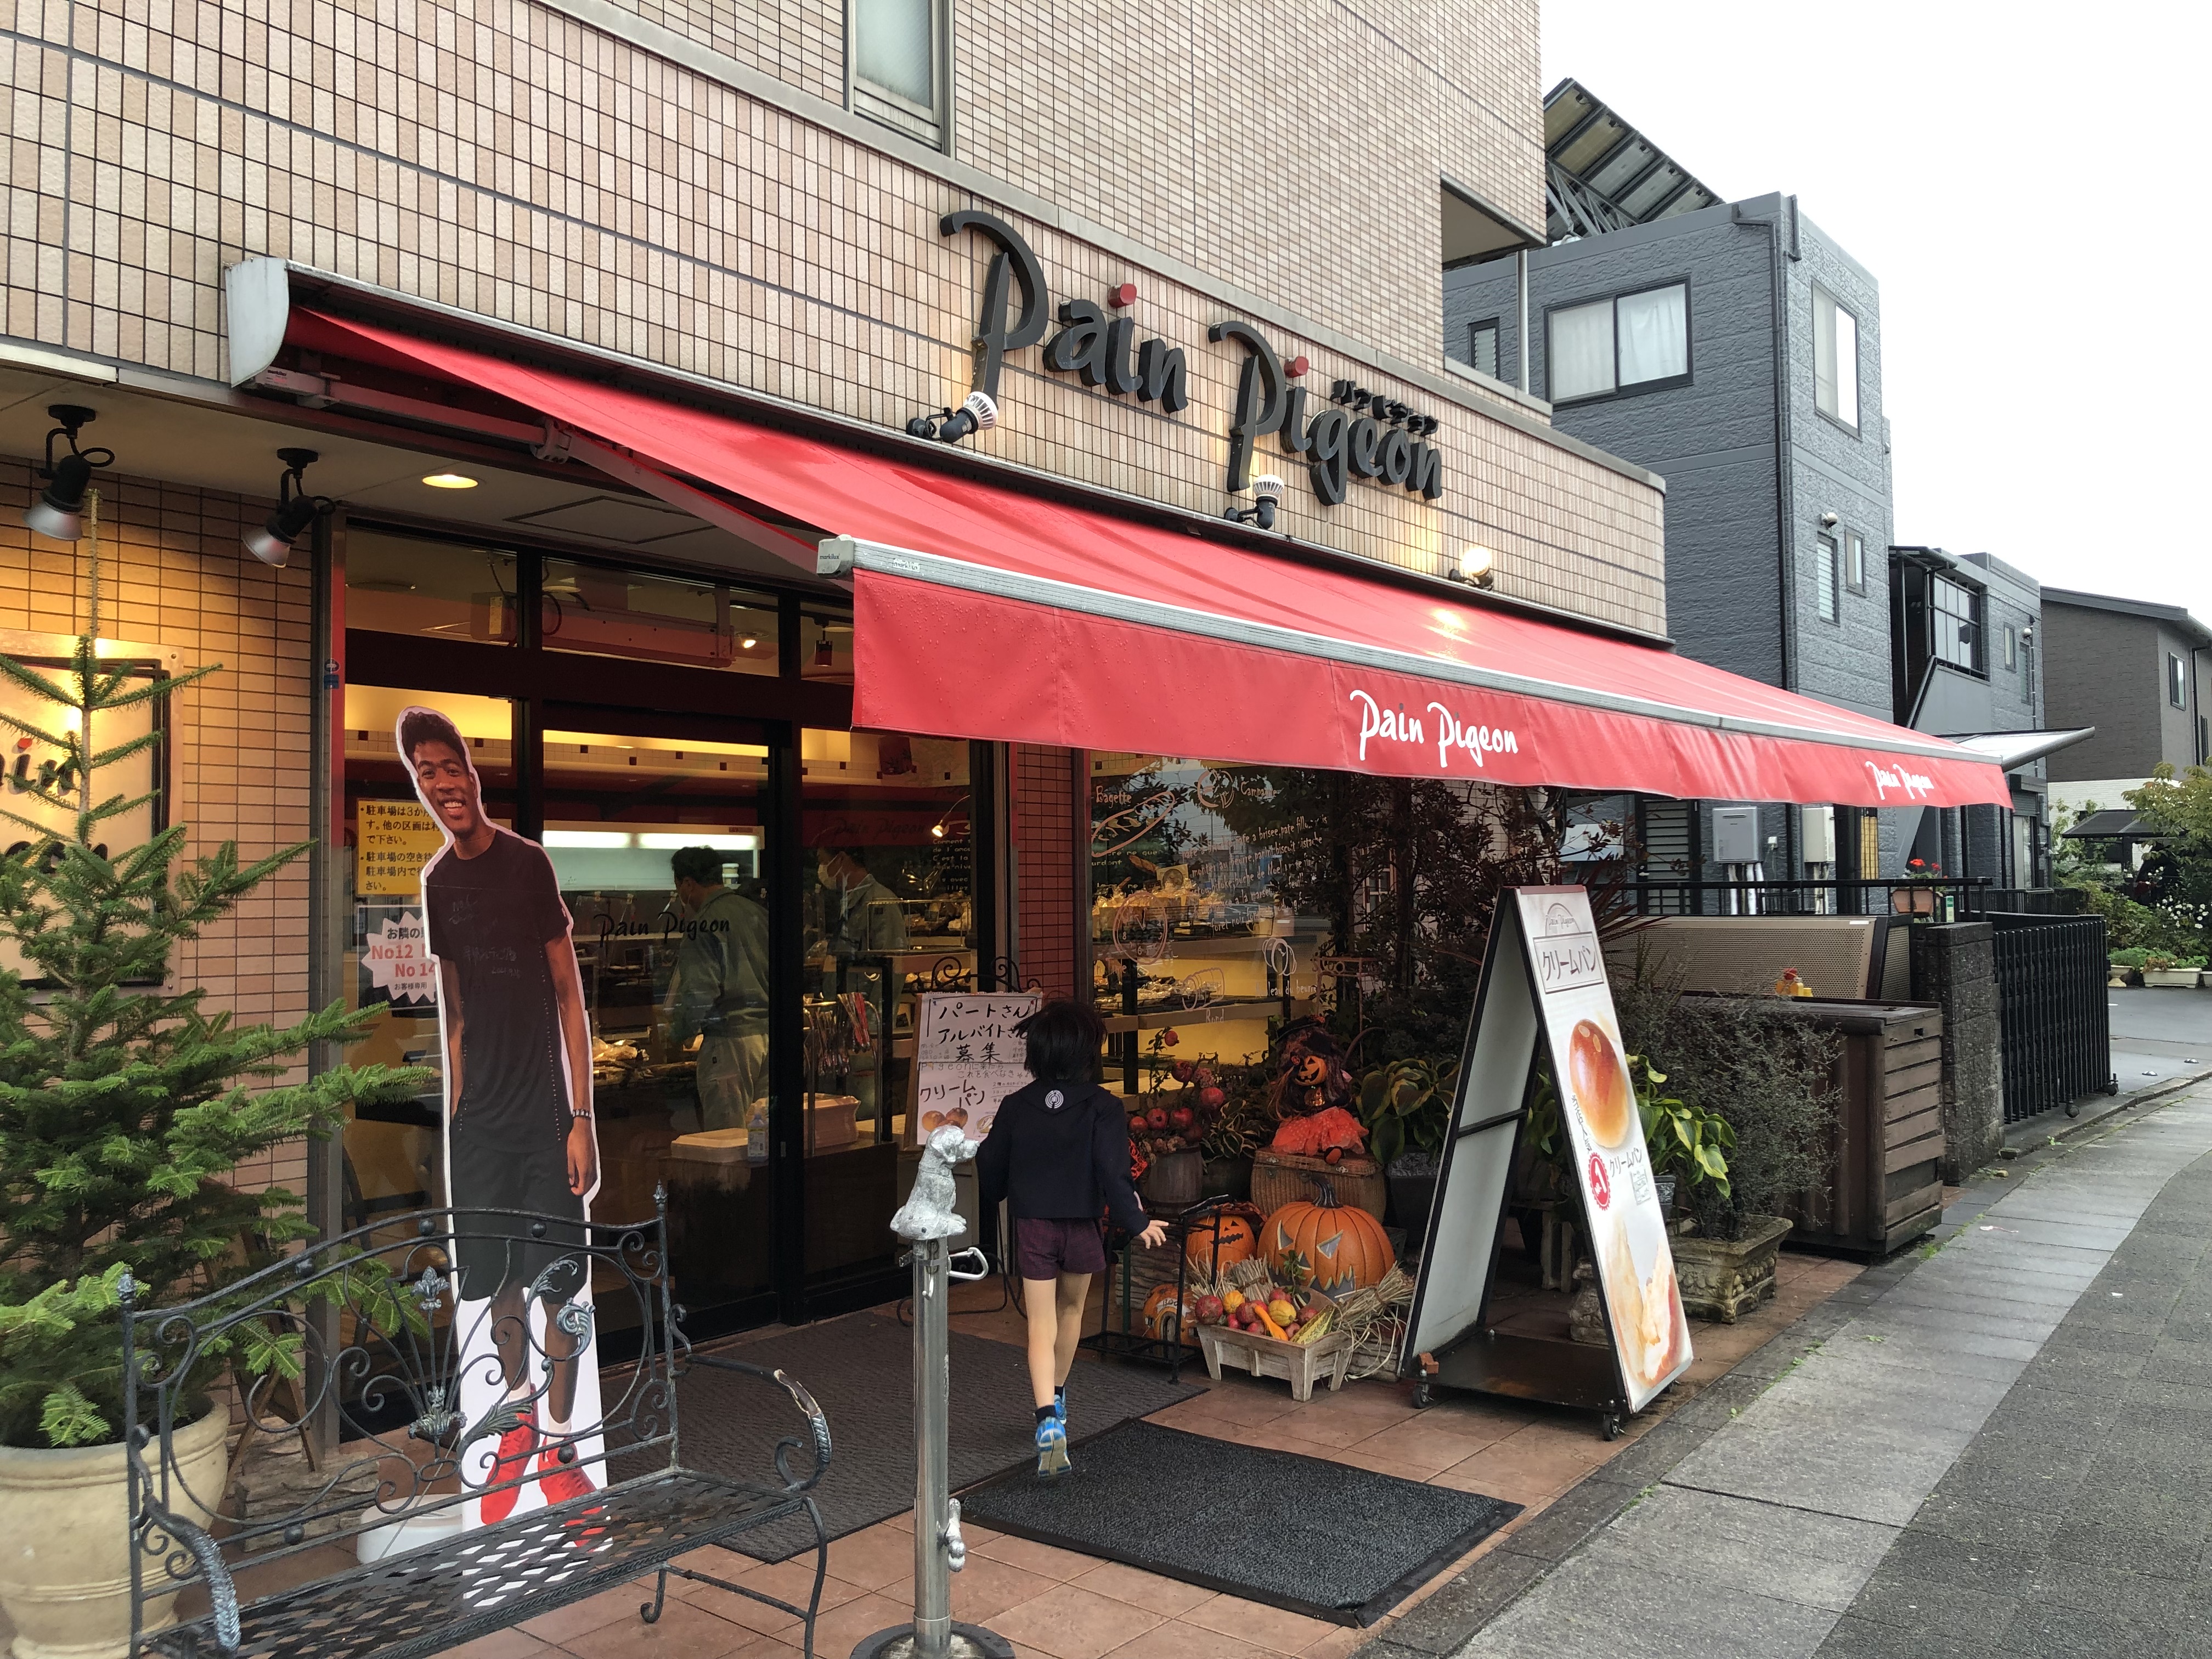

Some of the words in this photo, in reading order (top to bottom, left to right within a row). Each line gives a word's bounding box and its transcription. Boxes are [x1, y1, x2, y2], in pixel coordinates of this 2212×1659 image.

[940, 210, 1188, 413] Pain
[1208, 320, 1442, 506] Pigeon
[1349, 689, 1425, 761] Pain
[1427, 702, 1519, 768] Pigeon
[1096, 785, 1132, 808] Bagette
[387, 926, 425, 940] お隣の
[594, 913, 649, 948] Pain
[658, 911, 730, 944] Pigeon
[371, 944, 414, 960] No12
[1542, 945, 1596, 981] クリームパン
[938, 1002, 1031, 1019] パートさん
[1609, 1147, 1643, 1178] クリームパン
